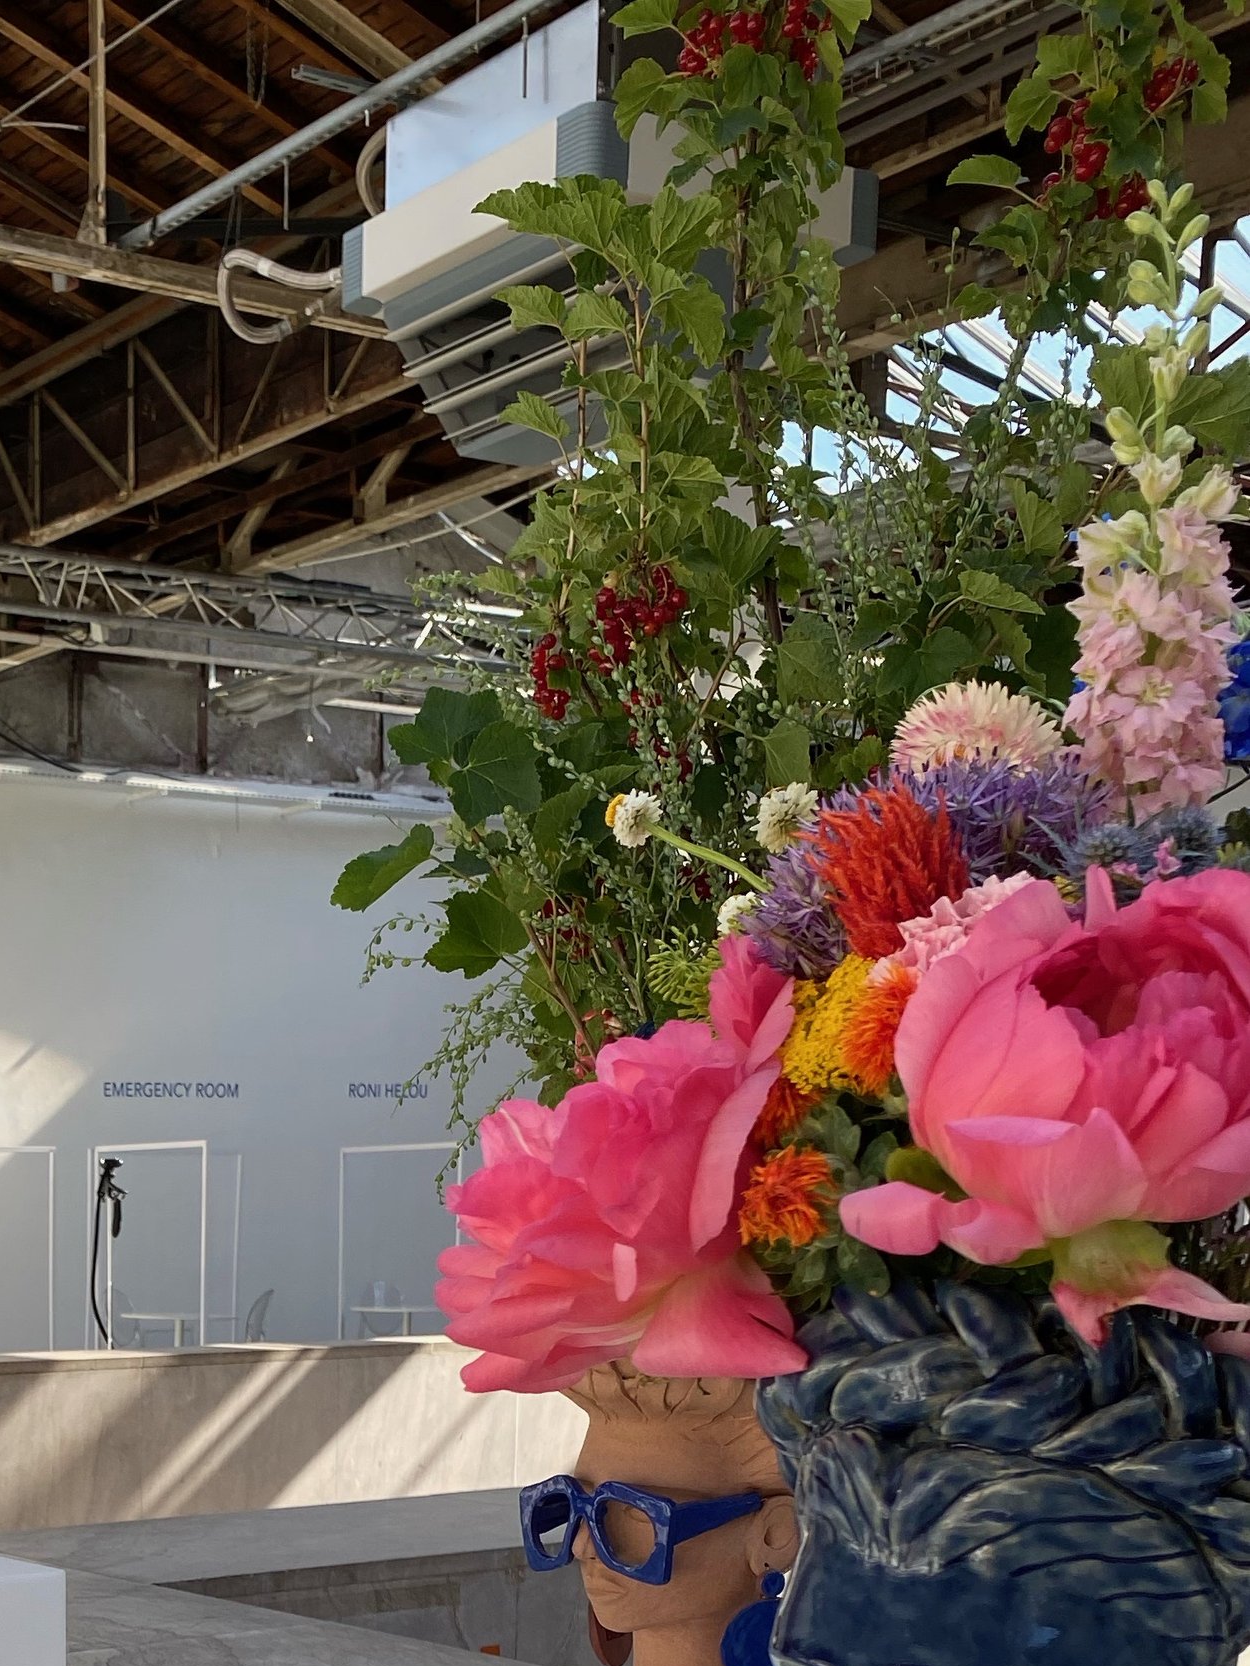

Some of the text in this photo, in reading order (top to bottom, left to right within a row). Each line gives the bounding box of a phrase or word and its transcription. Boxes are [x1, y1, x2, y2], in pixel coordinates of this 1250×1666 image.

[103, 1082, 239, 1098] EMERGENCY ROOM
[348, 1083, 382, 1098] RONI
